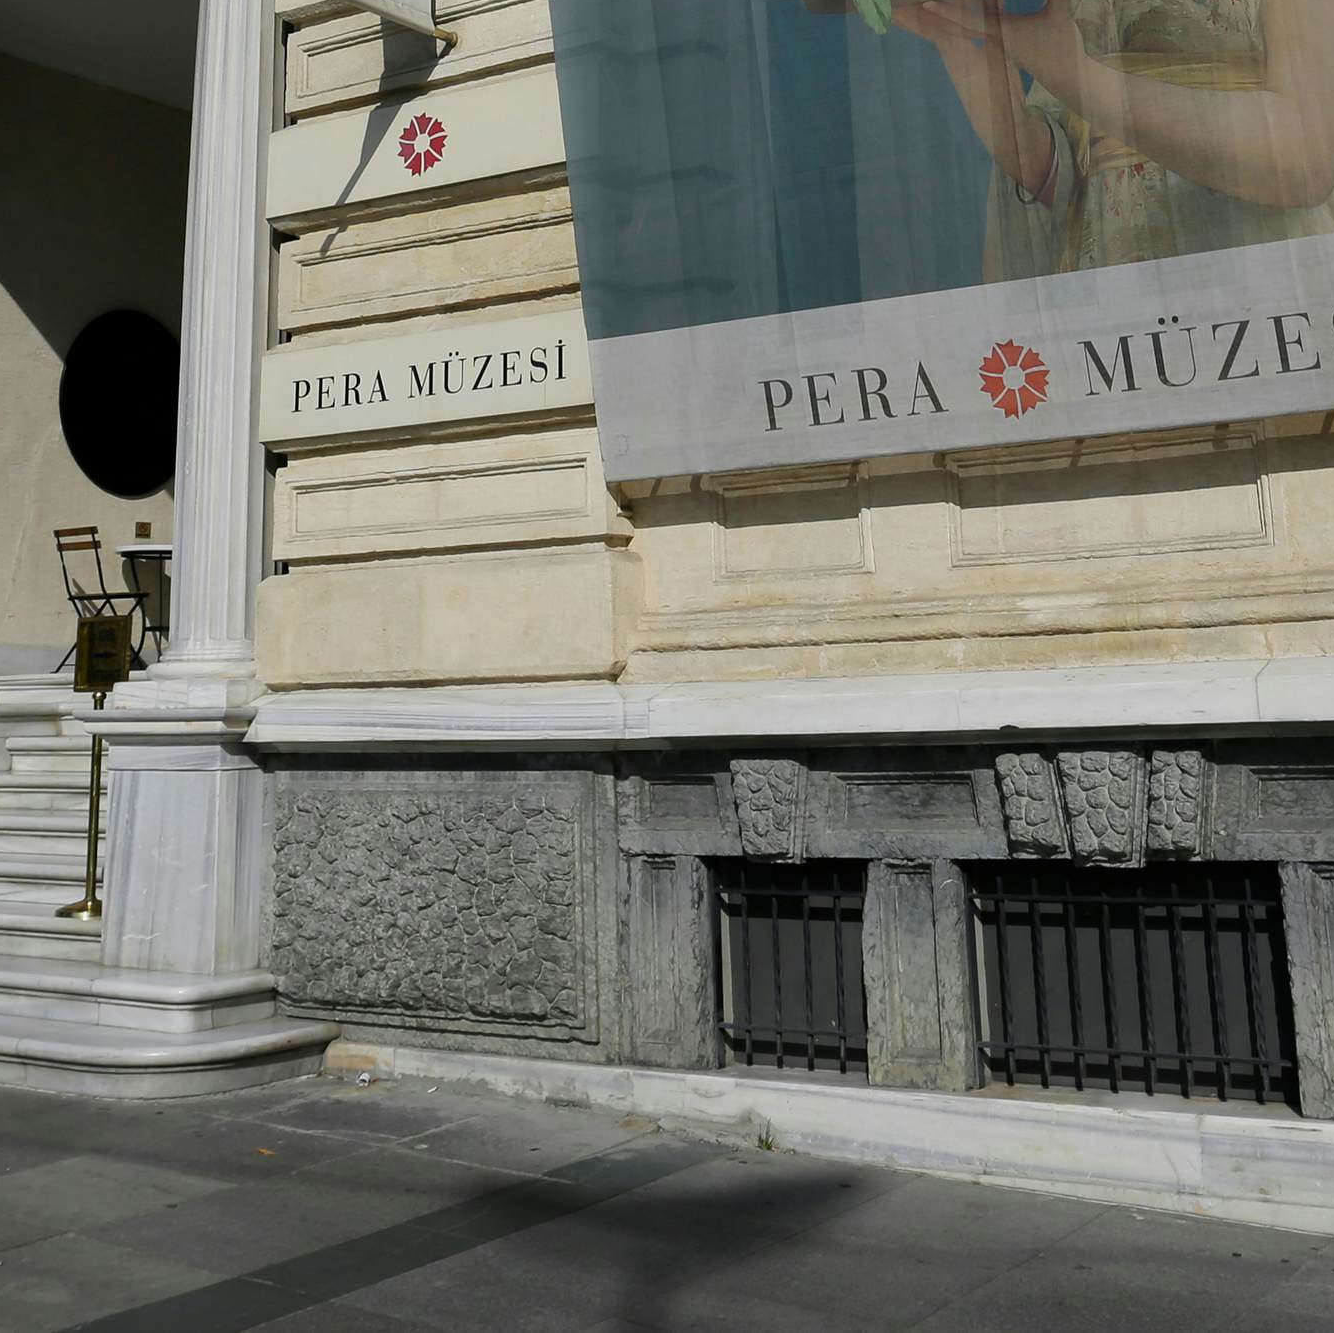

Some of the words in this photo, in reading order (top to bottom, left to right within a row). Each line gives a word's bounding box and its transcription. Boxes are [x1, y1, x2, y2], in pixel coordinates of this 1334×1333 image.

[291, 369, 389, 413] PERA
[408, 339, 568, 400] MÜZESİ
[759, 360, 949, 432] PERA
